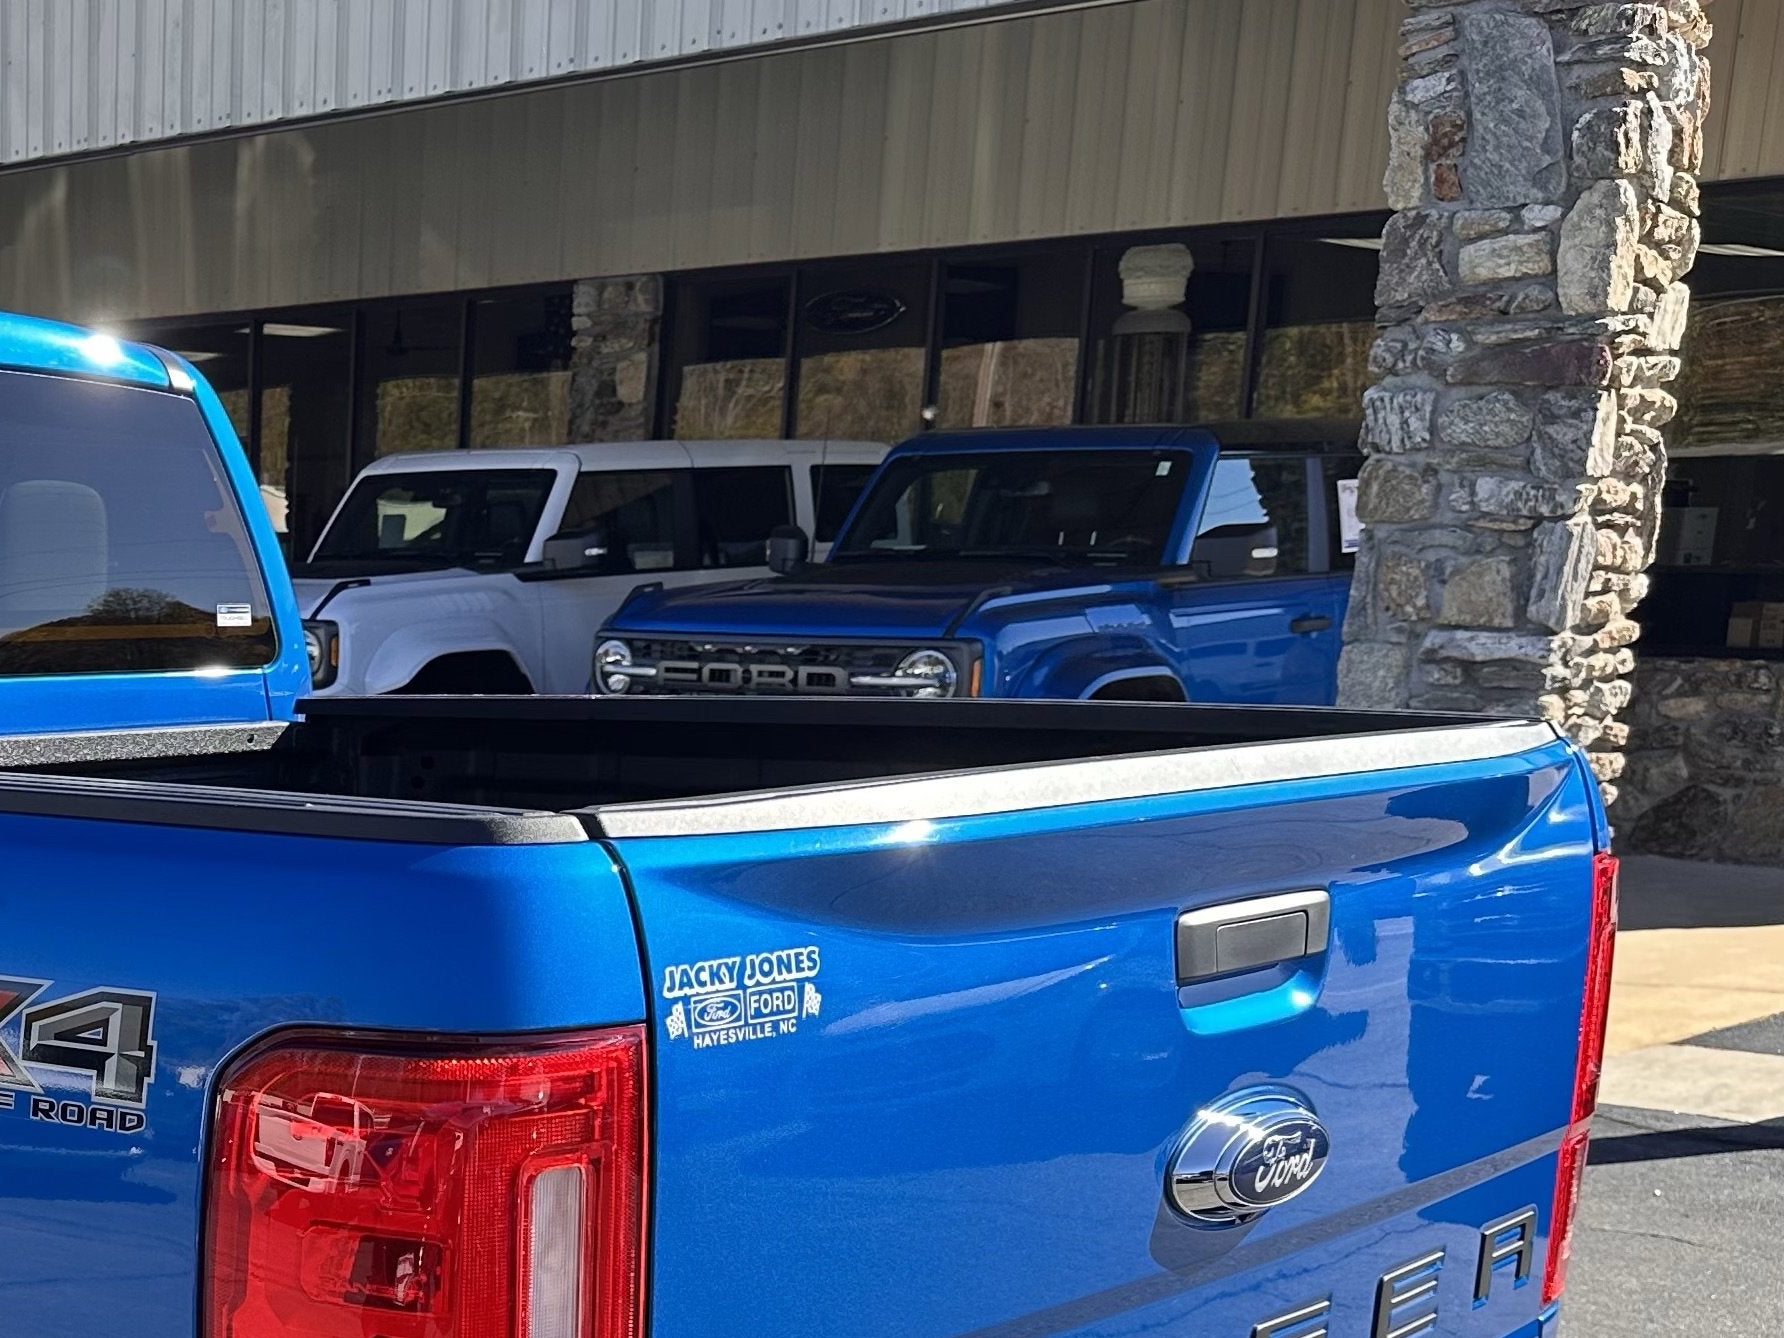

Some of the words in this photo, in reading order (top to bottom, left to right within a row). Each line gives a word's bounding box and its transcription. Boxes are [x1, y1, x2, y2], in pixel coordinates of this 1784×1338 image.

[658, 660, 851, 692] FORD
[664, 957, 741, 997] JACKY
[745, 946, 819, 986] JONES
[703, 1001, 732, 1021] Ford
[750, 990, 795, 1015] FORD
[693, 1023, 777, 1049] HAYESVILLE,
[779, 1019, 797, 1034] NC
[30, 1095, 147, 1135] ROAD
[1254, 1131, 1317, 1193] Ford
